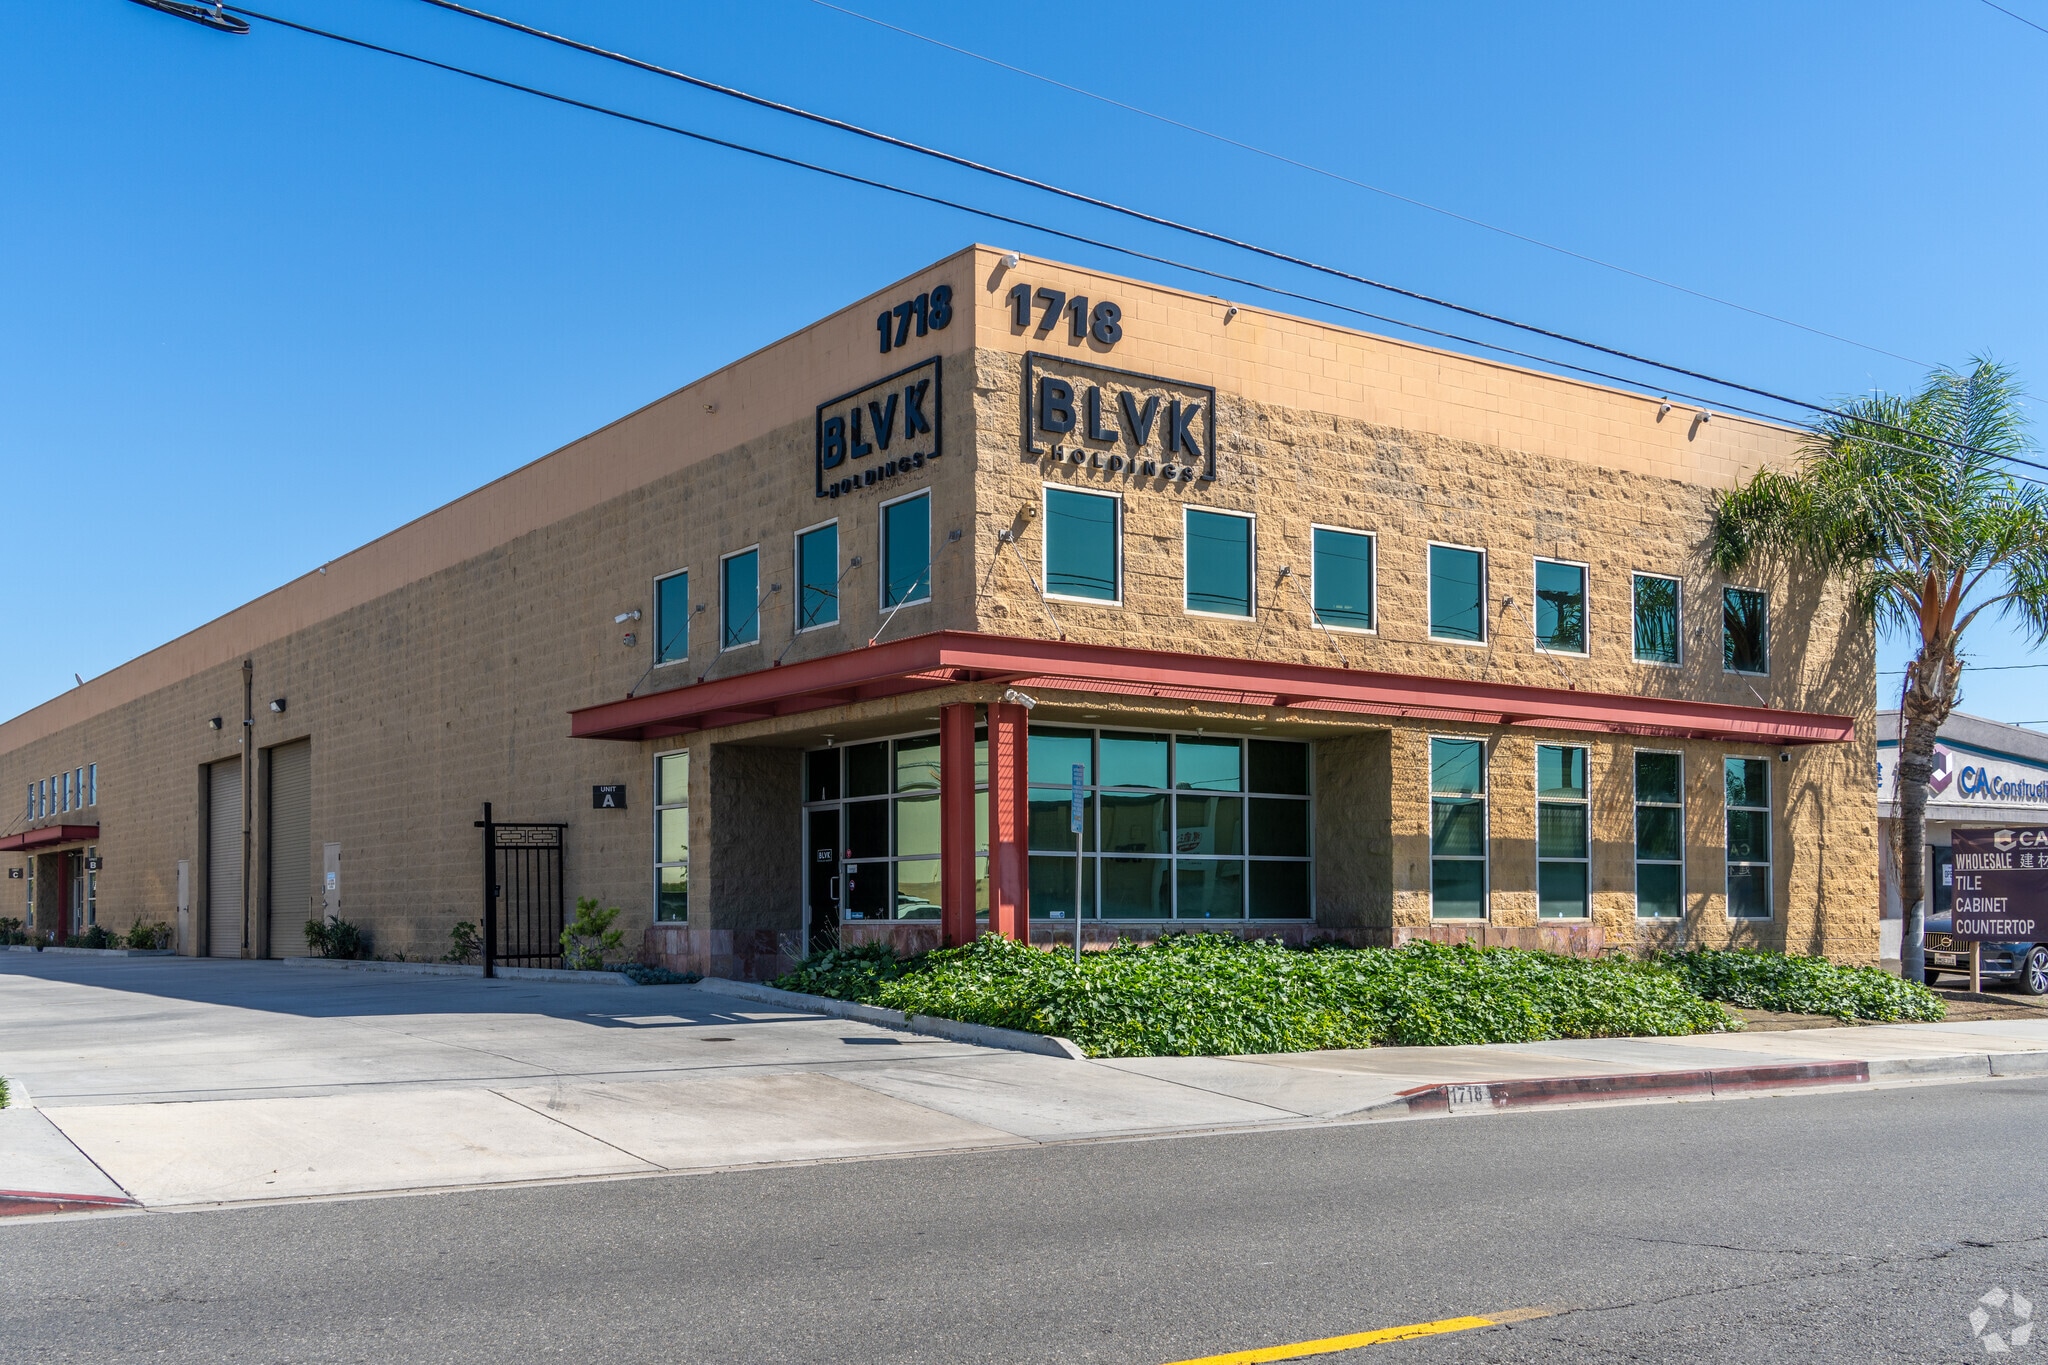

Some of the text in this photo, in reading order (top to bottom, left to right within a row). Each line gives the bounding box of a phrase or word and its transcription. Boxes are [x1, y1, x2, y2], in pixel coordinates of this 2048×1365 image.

[877, 285, 952, 354] 1718
[1011, 283, 1123, 344] 1718
[824, 379, 930, 470] BLVK
[1041, 376, 1201, 456] BLVK
[1051, 444, 1194, 483] HOLDINGS
[829, 452, 924, 499] HOLDINGS
[1961, 766, 1991, 795] CA
[602, 794, 615, 807] A
[2019, 830, 2048, 847] CA
[90, 861, 97, 869] B
[1955, 852, 2013, 870] WHOLESALE
[1955, 875, 1982, 891] TILE
[1955, 897, 2008, 913] CABINET
[1956, 919, 2036, 935] COUNTERTOP
[1450, 1085, 1483, 1103] 1718
